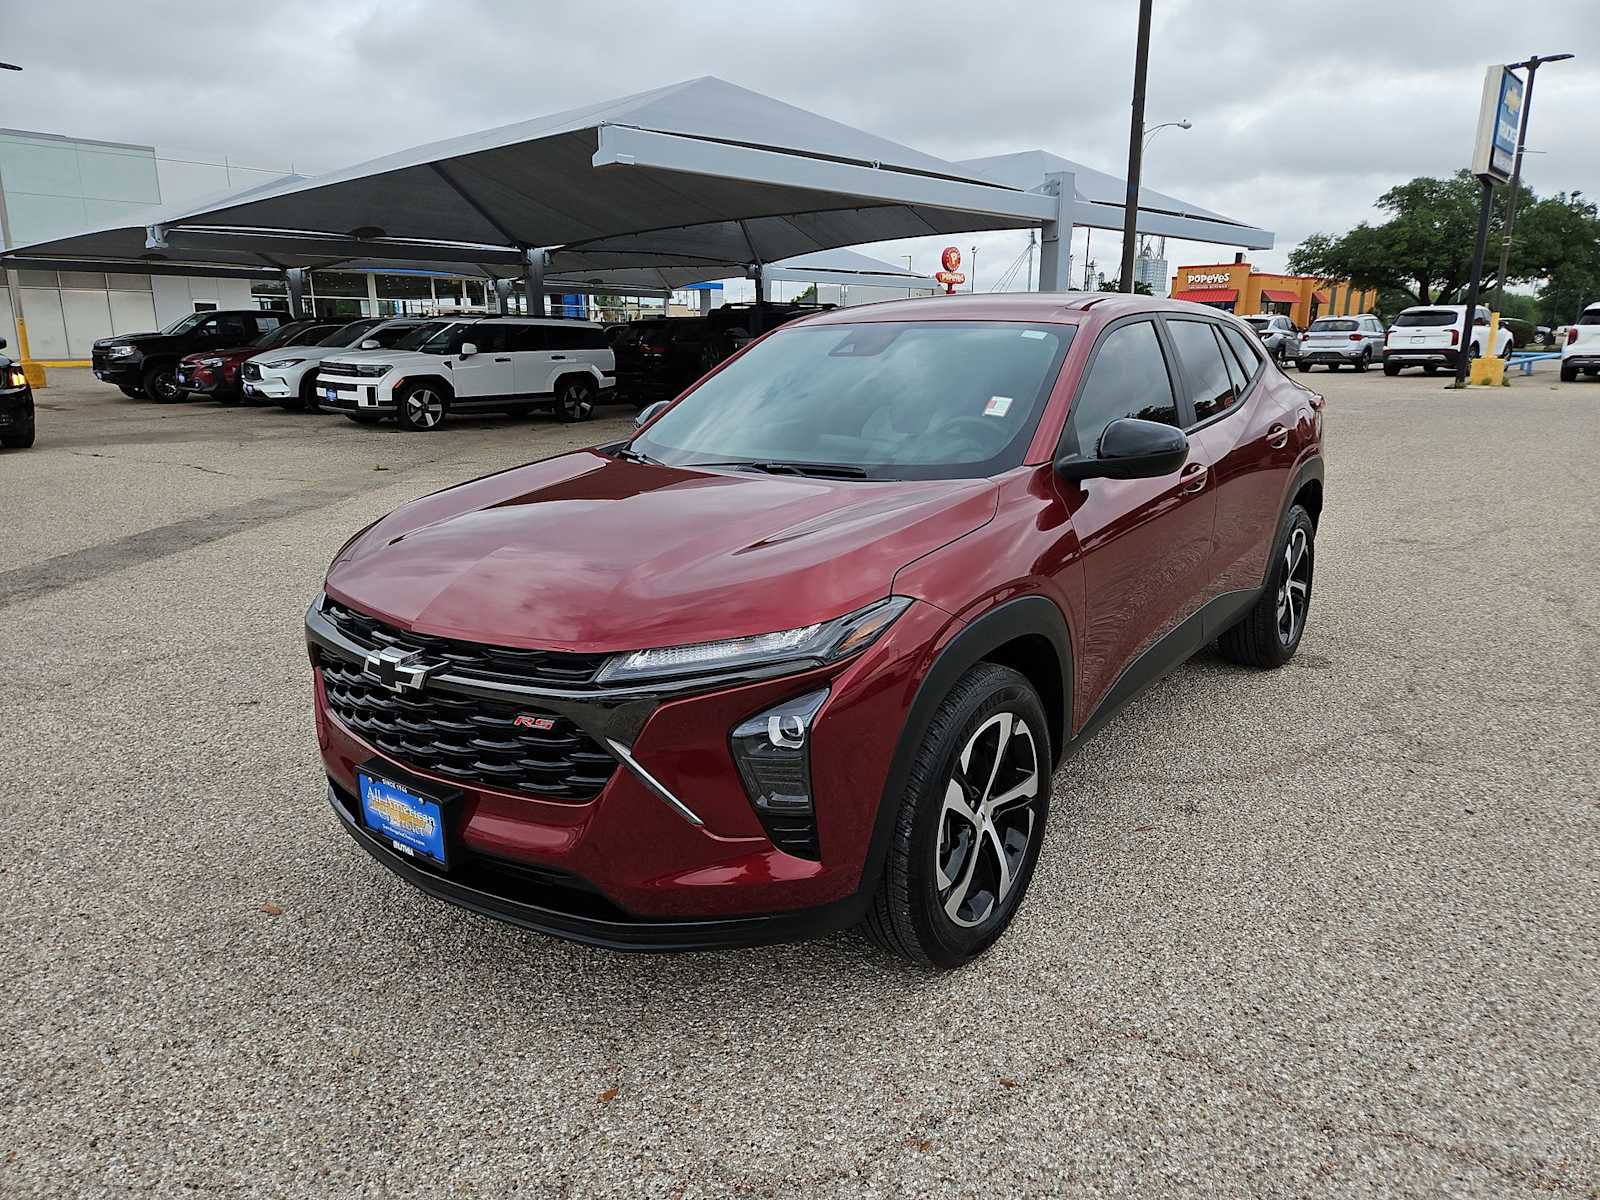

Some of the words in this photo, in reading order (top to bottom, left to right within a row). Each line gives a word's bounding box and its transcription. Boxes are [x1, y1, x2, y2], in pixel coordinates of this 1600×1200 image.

[514, 716, 555, 730] RS
[367, 786, 381, 803] All
[386, 794, 435, 826] American
